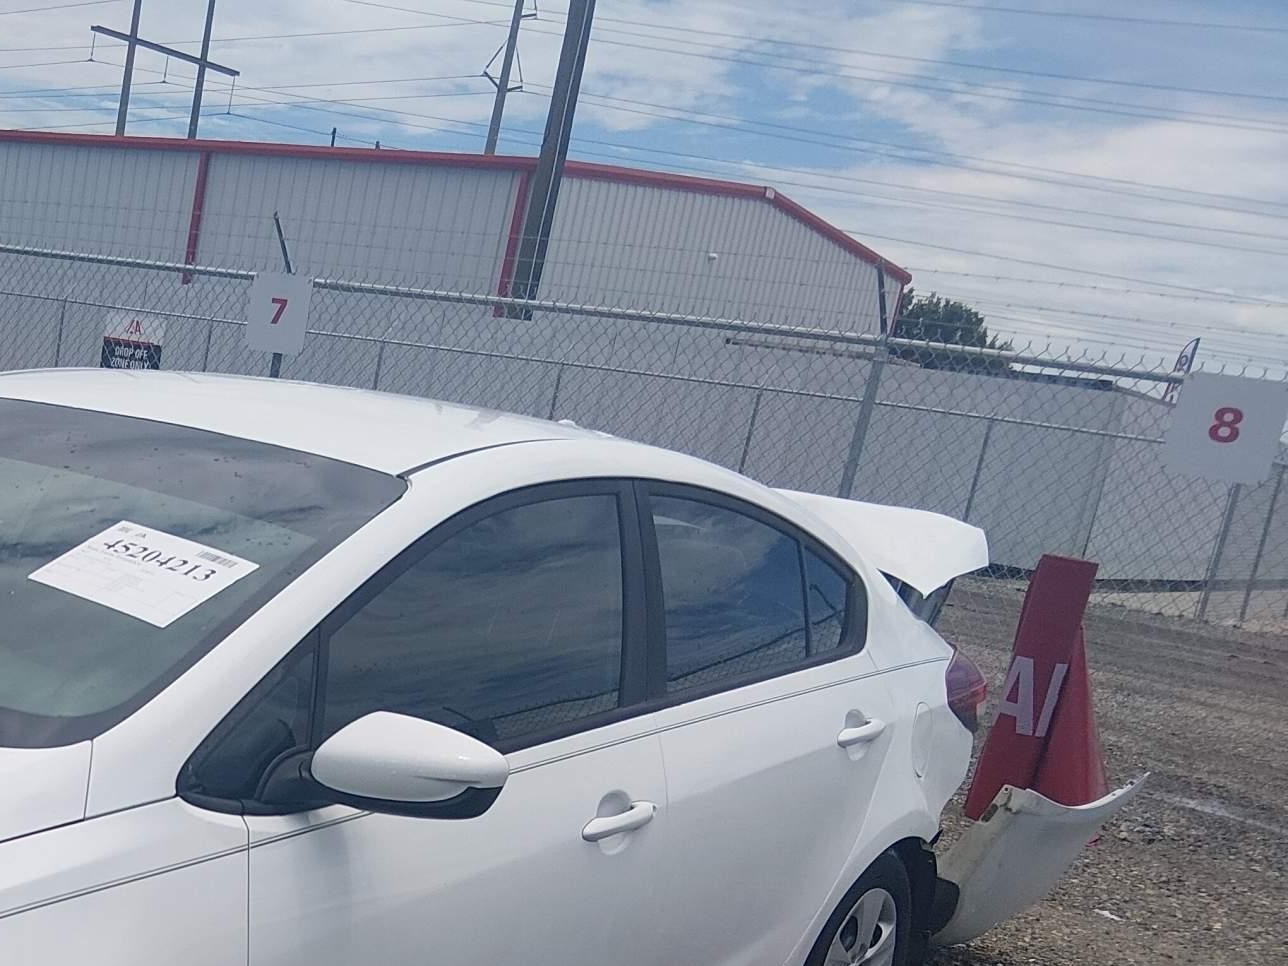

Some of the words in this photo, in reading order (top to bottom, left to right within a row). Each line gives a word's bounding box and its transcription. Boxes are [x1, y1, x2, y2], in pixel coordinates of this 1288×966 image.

[270, 297, 288, 325] 7
[114, 345, 134, 358] DROP
[1208, 407, 1244, 443] 8
[103, 539, 217, 582] 45204213
